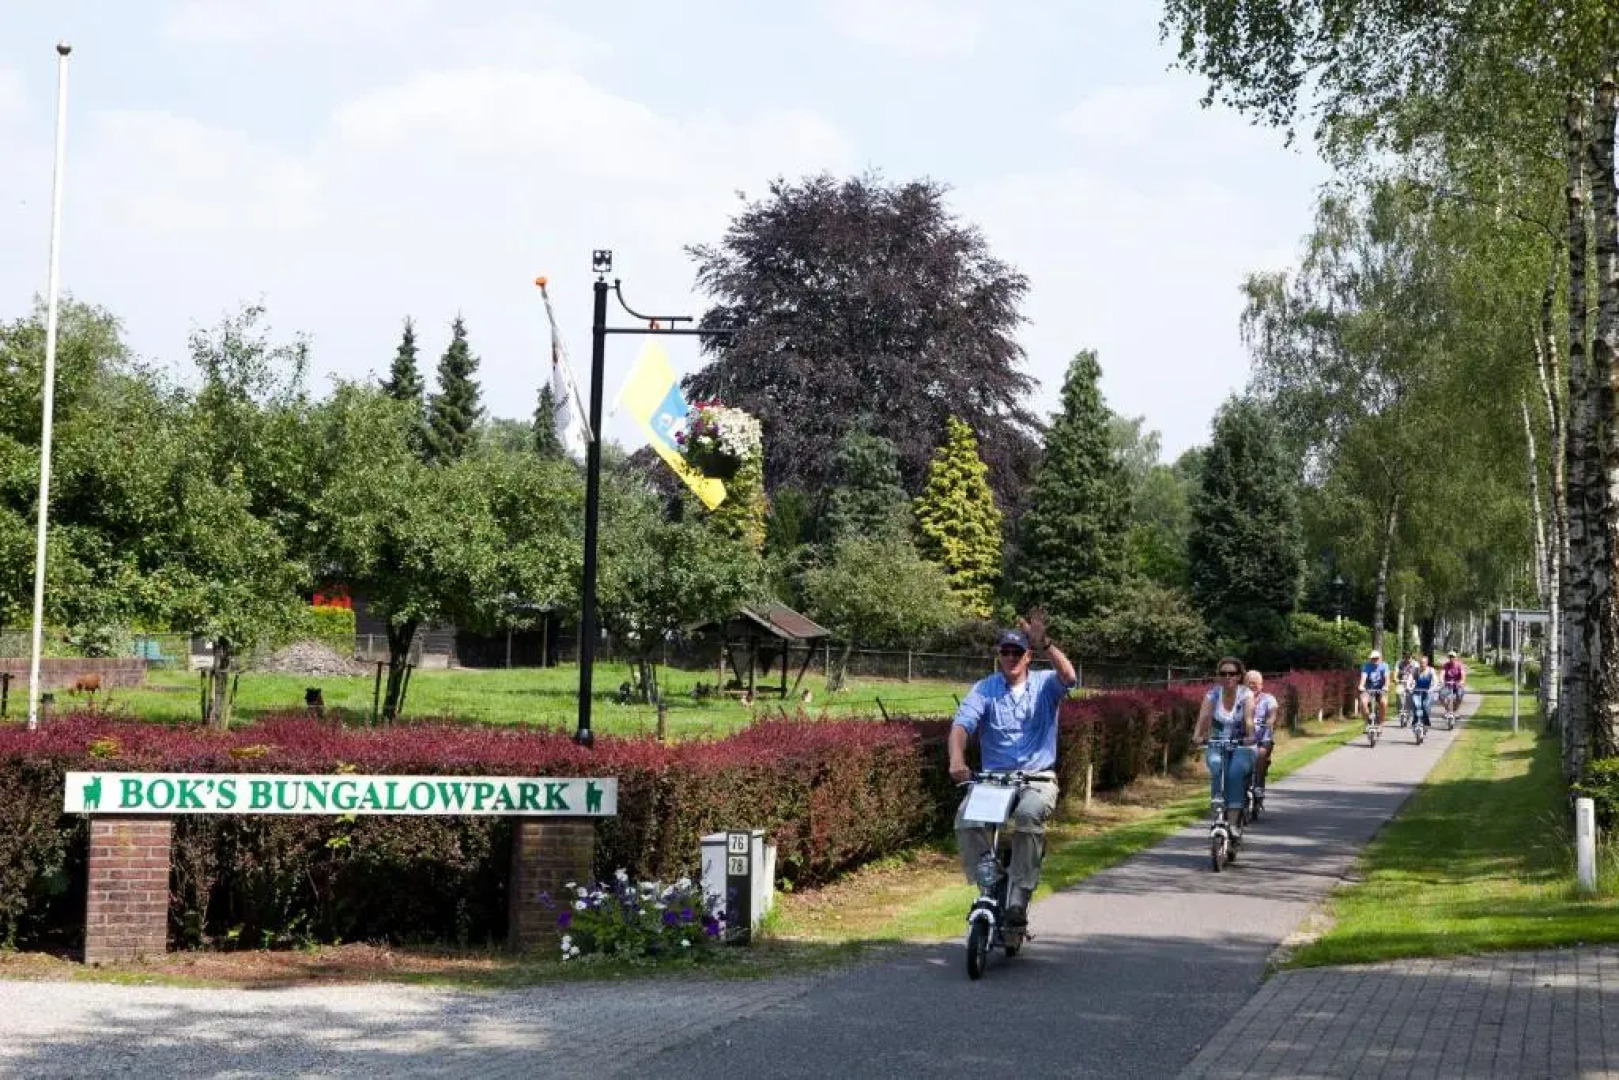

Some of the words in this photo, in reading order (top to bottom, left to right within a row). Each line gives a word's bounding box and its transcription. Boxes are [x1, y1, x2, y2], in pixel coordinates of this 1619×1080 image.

[118, 778, 237, 809] BOK'S
[248, 780, 570, 811] BUNGALOWPARK
[732, 836, 744, 850] 76
